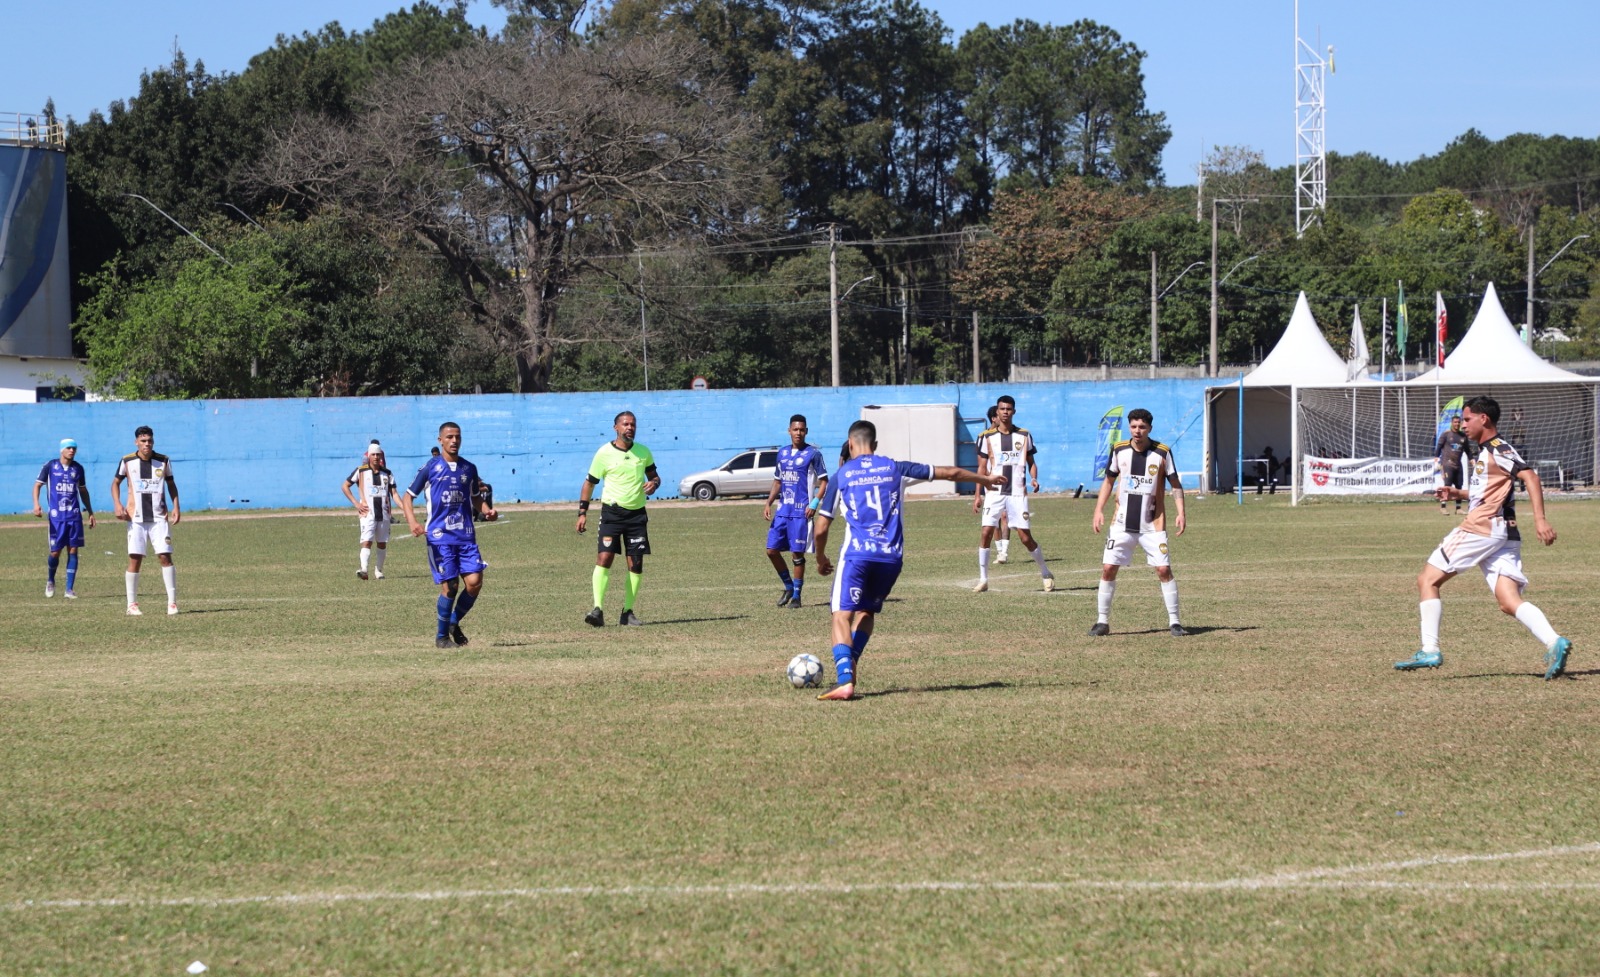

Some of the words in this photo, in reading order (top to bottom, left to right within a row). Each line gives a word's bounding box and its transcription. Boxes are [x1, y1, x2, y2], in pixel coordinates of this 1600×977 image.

[1337, 464, 1382, 474] Assoação
[1383, 464, 1392, 473] de
[1394, 464, 1421, 473] Clubes
[1422, 464, 1432, 472] de
[1335, 478, 1363, 486] Futebol
[1364, 477, 1394, 486] Amador
[1396, 477, 1406, 485] de
[865, 486, 883, 520] 4
